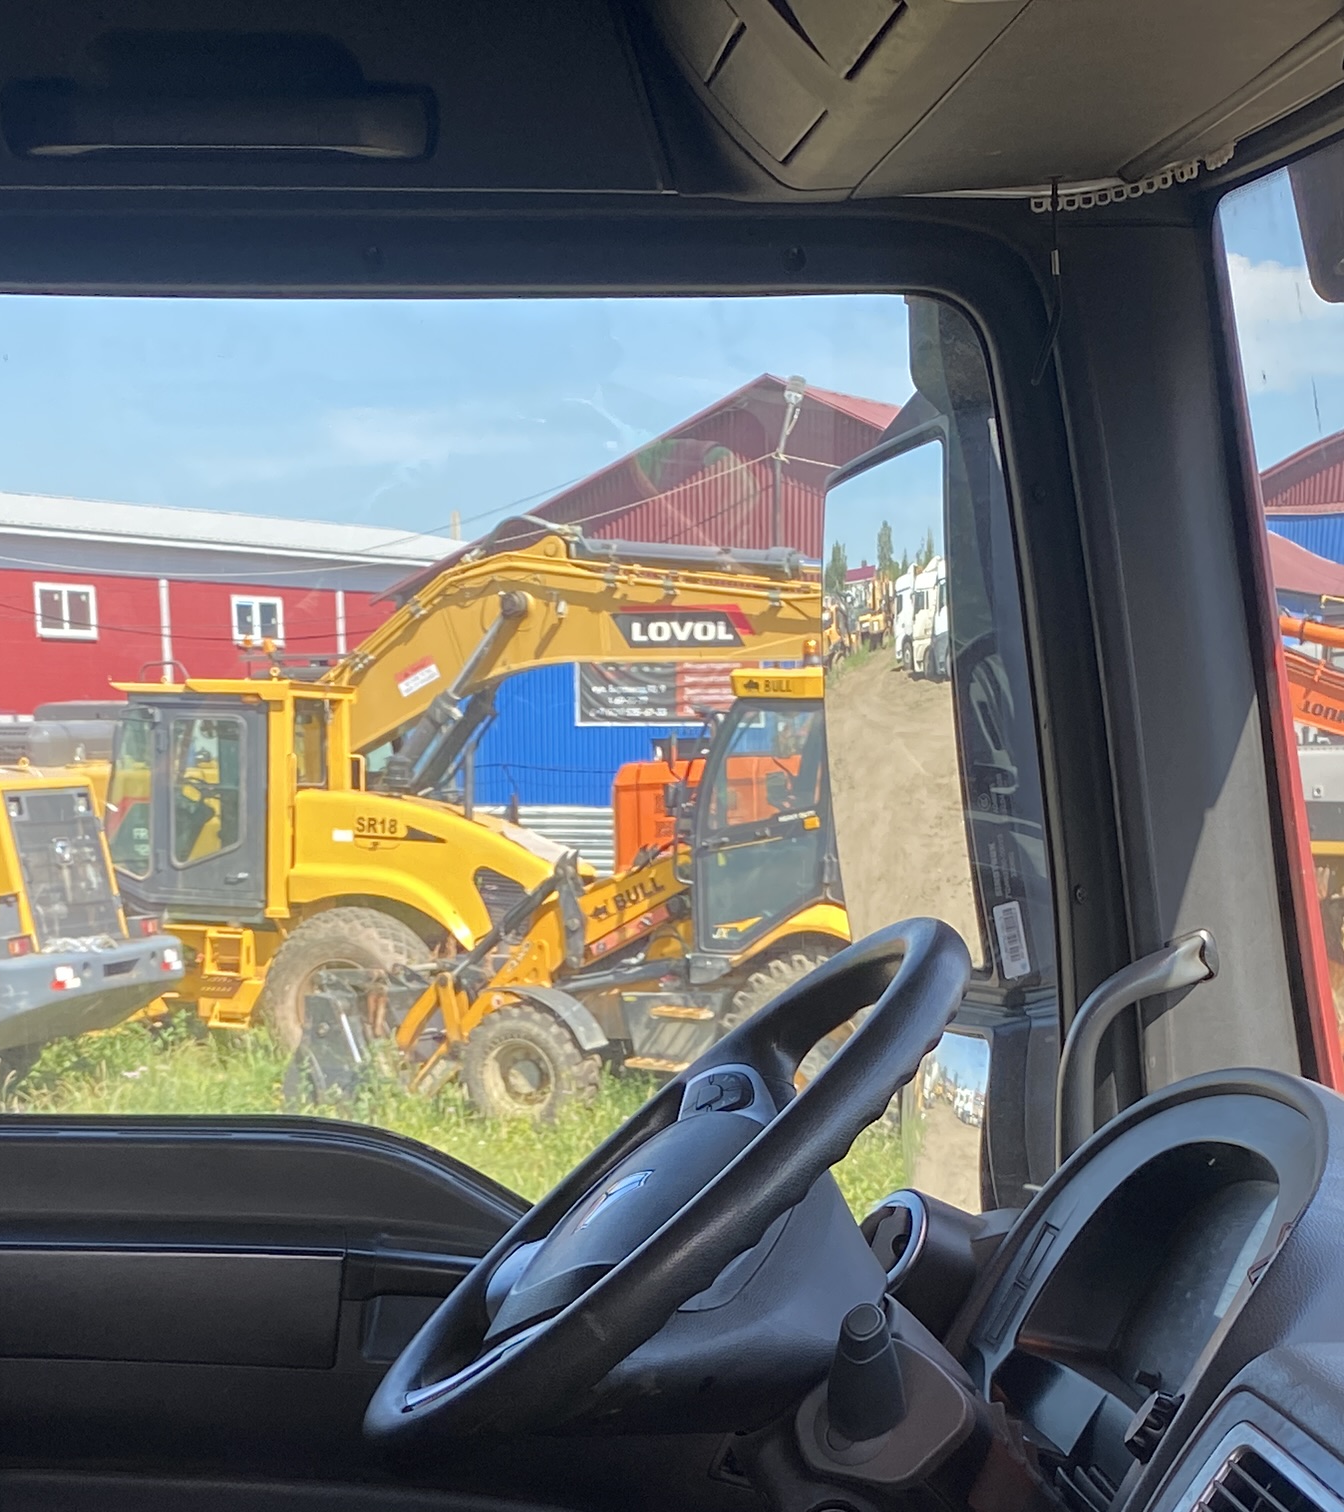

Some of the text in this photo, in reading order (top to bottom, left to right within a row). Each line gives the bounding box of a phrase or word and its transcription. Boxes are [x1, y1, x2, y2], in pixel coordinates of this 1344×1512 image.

[631, 621, 734, 642] LOVOL
[764, 679, 792, 692] BULL
[356, 816, 398, 834] SR18
[613, 877, 665, 911] BULL
